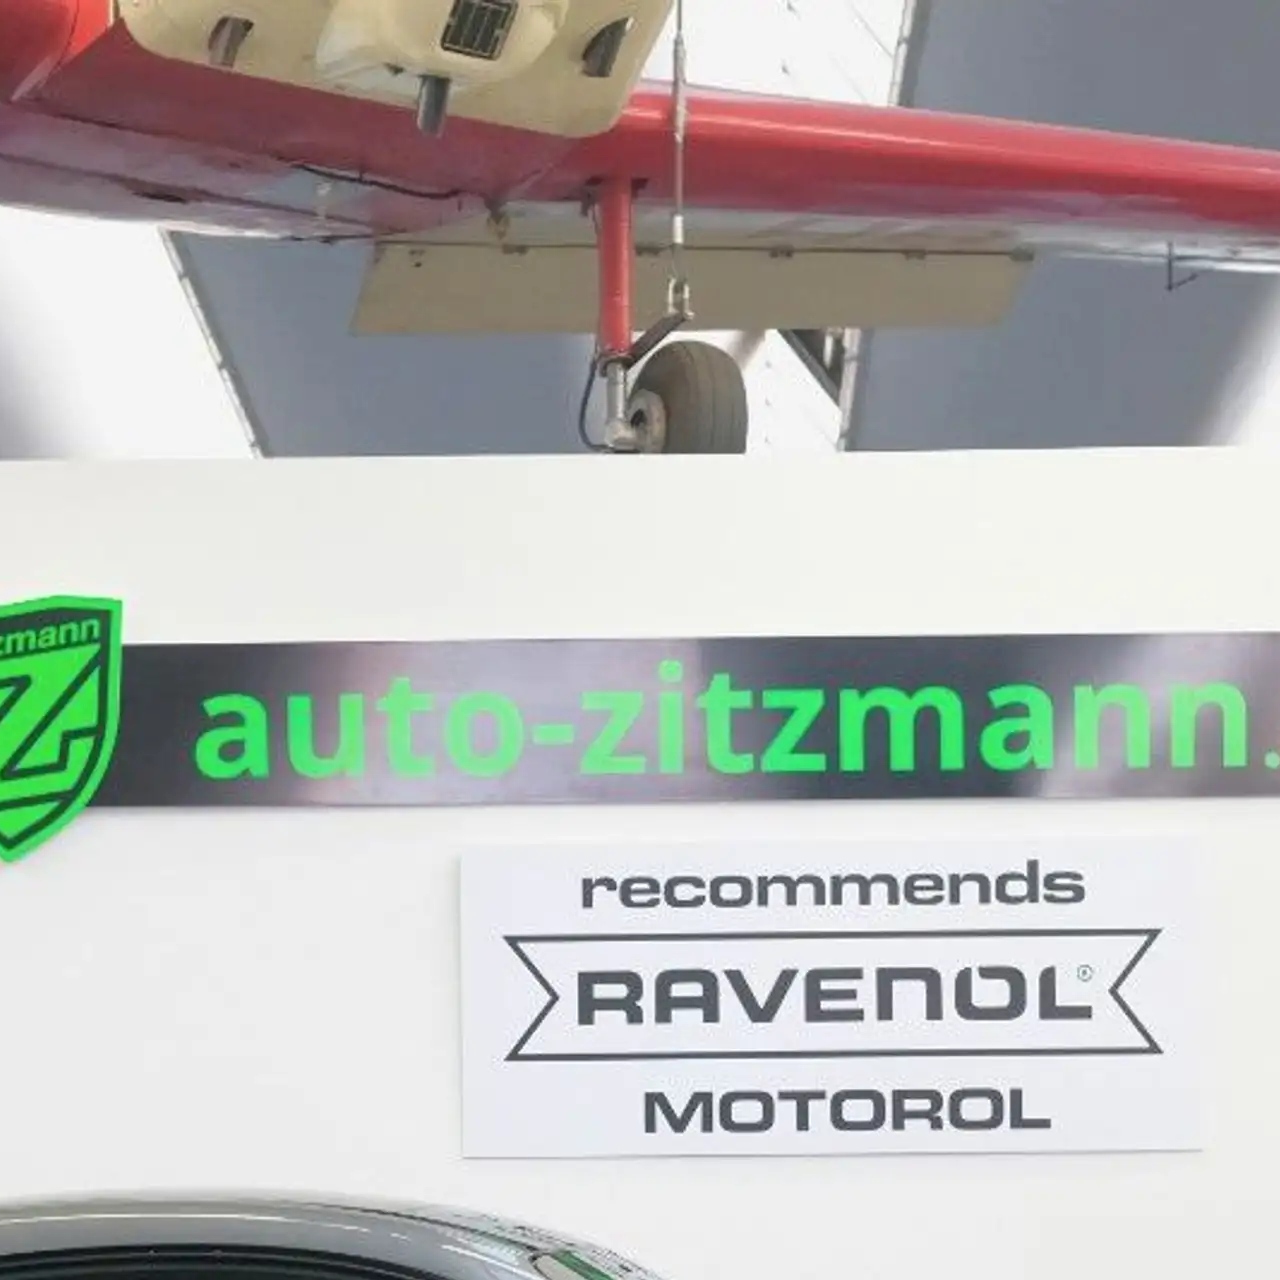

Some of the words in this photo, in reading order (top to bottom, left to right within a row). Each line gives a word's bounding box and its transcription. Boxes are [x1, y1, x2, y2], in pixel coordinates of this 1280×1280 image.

[581, 859, 1086, 909] recommends
[576, 965, 1093, 1026] RAVENOL
[643, 1087, 1052, 1134] MOTOROL
